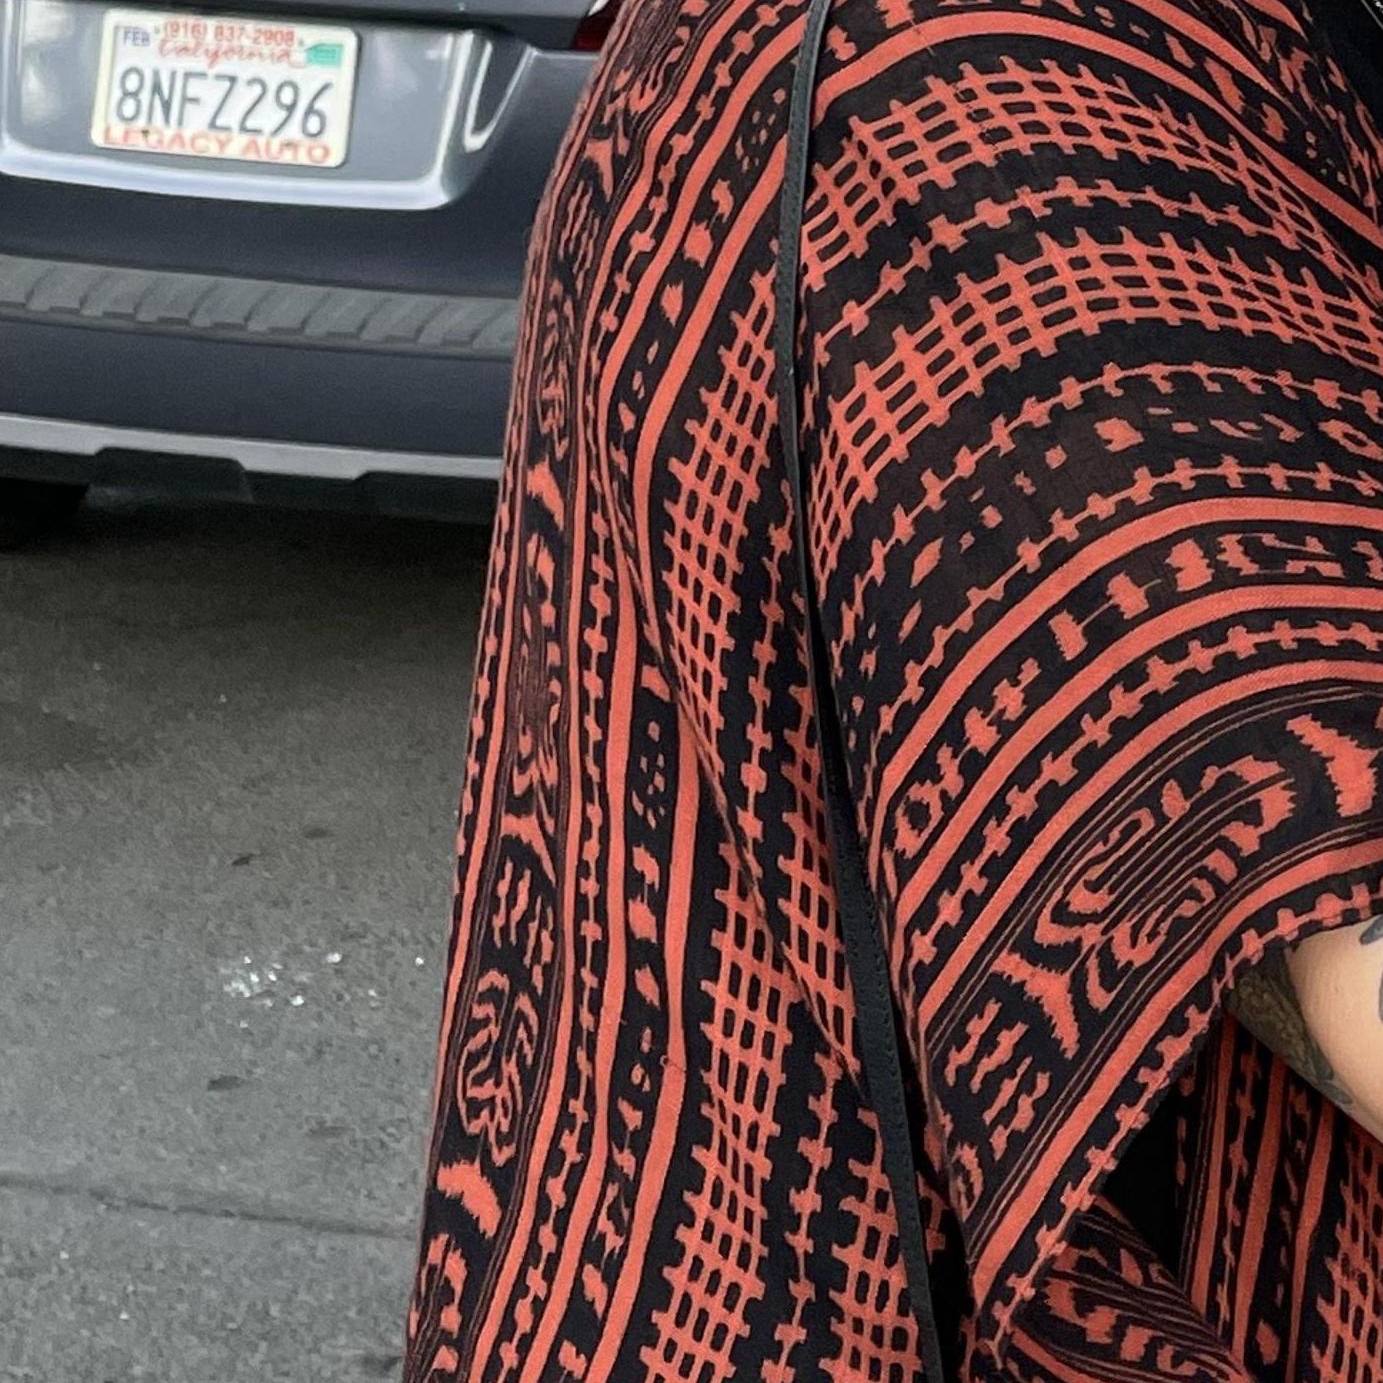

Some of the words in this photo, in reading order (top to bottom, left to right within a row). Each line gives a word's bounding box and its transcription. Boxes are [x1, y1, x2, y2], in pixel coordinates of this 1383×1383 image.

[157, 35, 299, 69] California
[116, 66, 334, 138] 8NFZ296
[104, 126, 235, 155] LEGACY
[241, 134, 331, 165] AUTO
